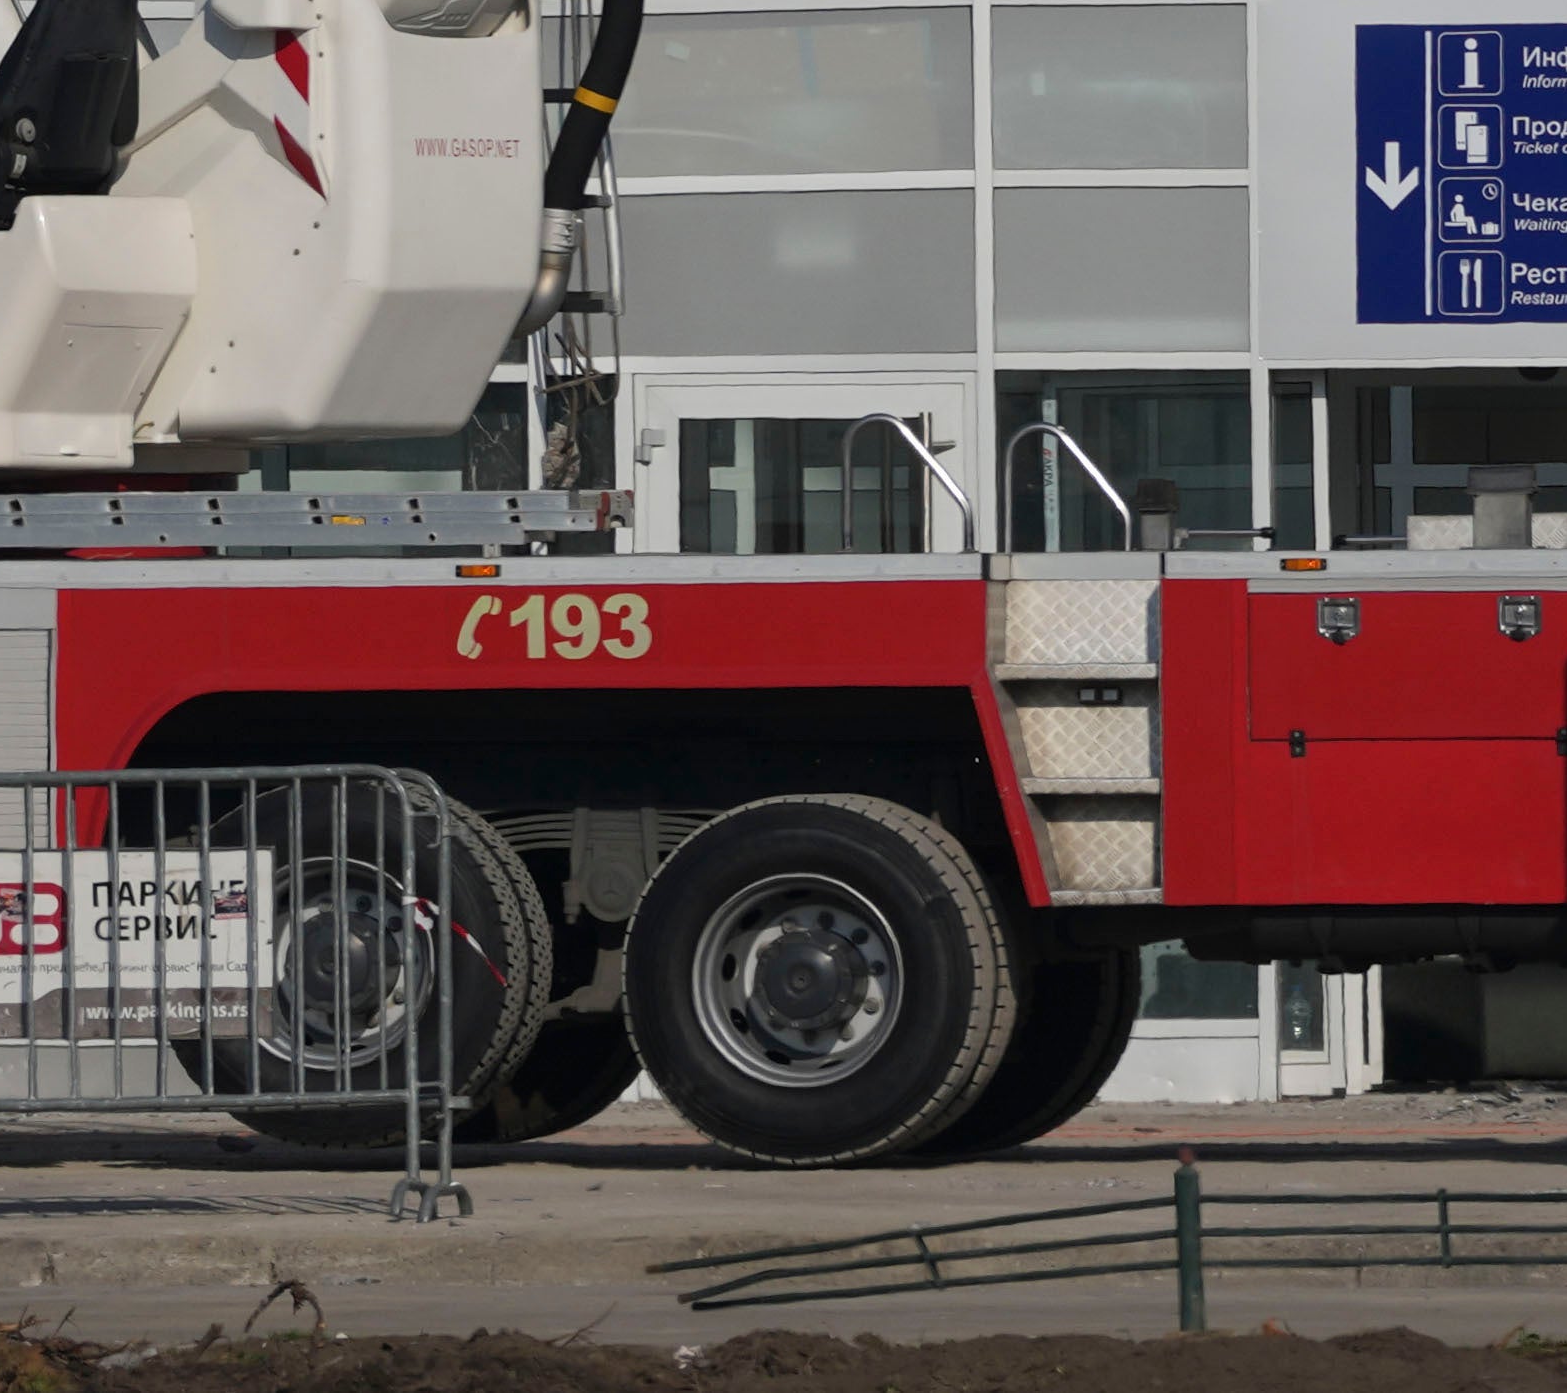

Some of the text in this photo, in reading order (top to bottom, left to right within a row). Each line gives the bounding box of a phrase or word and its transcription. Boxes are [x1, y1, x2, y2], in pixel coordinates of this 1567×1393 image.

[414, 138, 520, 158] WWW.GASOP.NET
[1514, 141, 1559, 154] Ticket
[510, 593, 653, 659] 193
